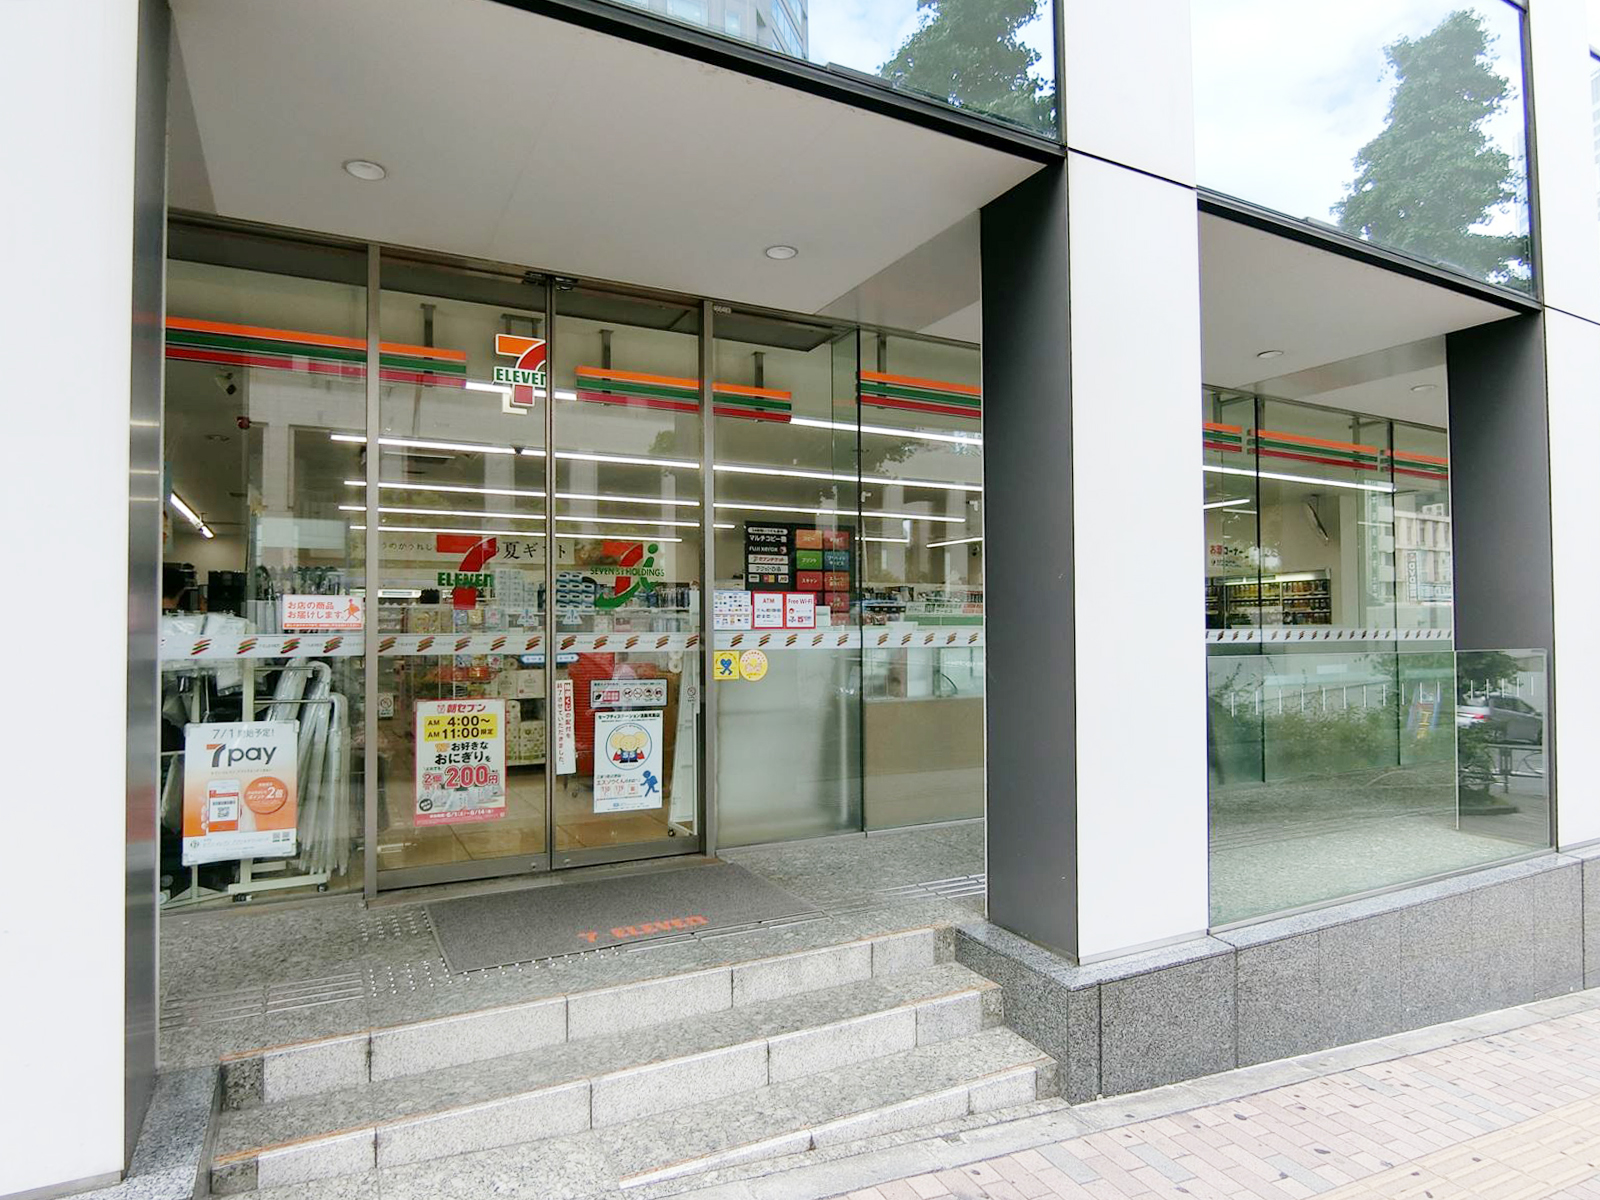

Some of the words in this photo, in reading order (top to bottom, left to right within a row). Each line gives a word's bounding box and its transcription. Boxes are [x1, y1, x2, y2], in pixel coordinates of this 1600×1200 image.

[442, 727, 479, 739] 11:00
[451, 741, 489, 751] お好きな
